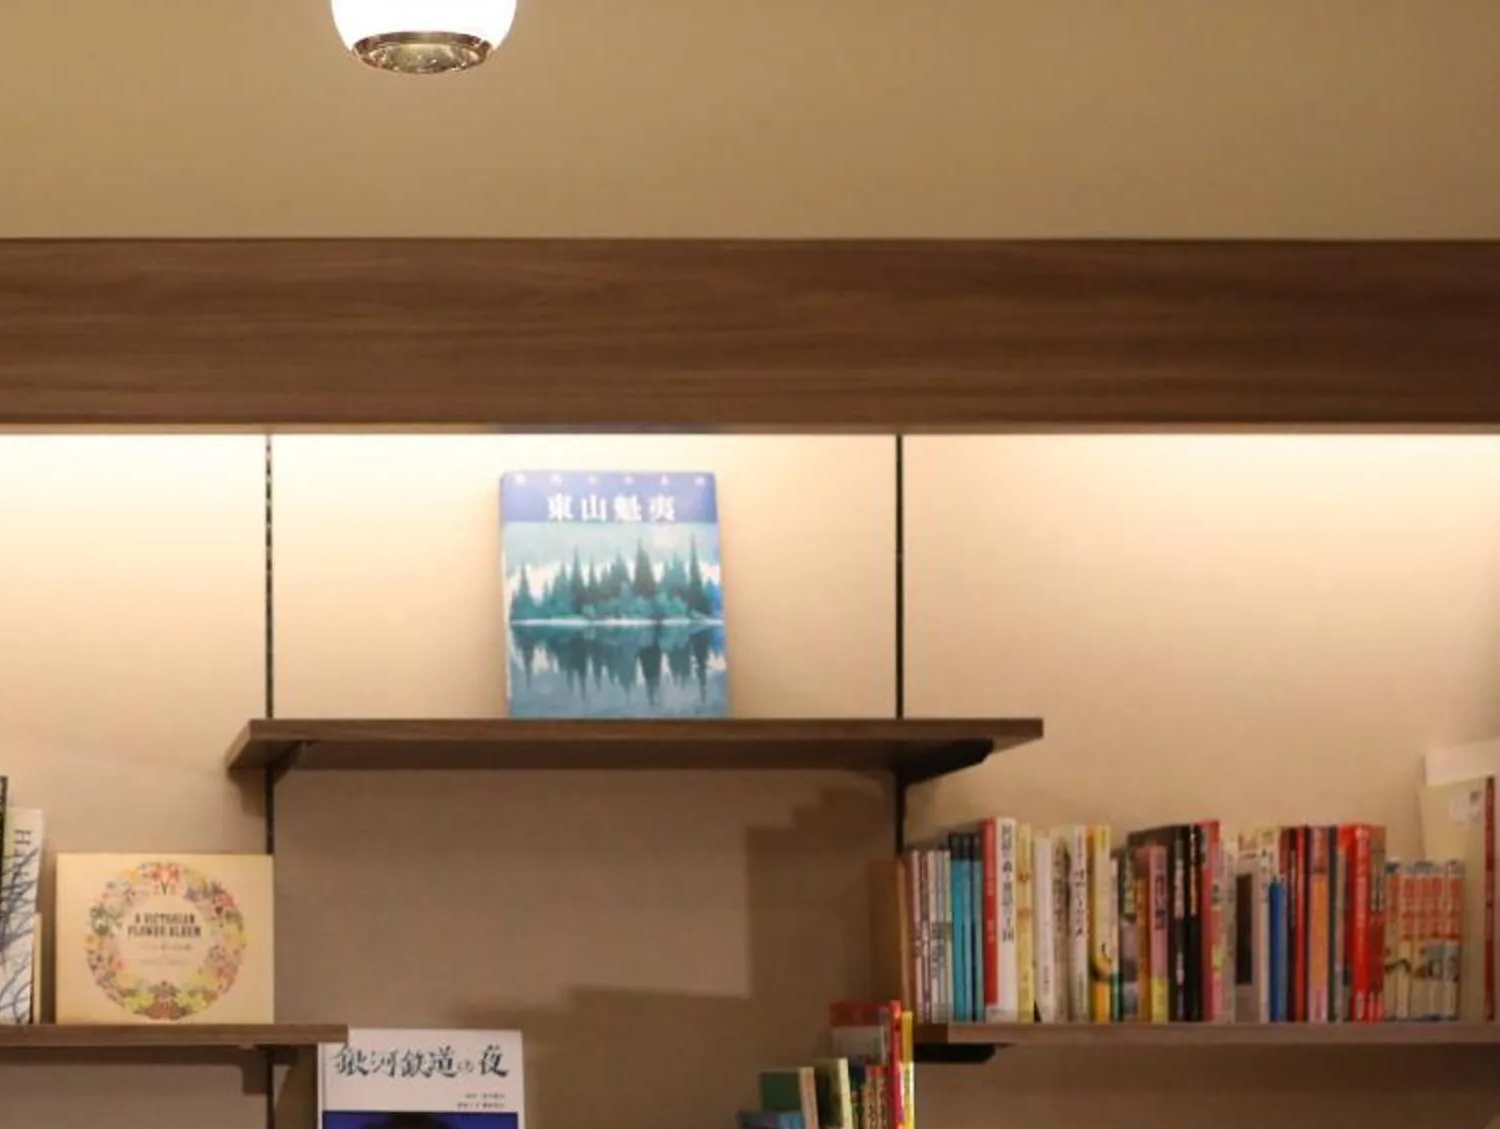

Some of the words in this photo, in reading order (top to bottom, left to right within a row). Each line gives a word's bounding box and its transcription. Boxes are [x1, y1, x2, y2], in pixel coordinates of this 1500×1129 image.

[334, 1044, 509, 1078] 銀河鉄道の夜
